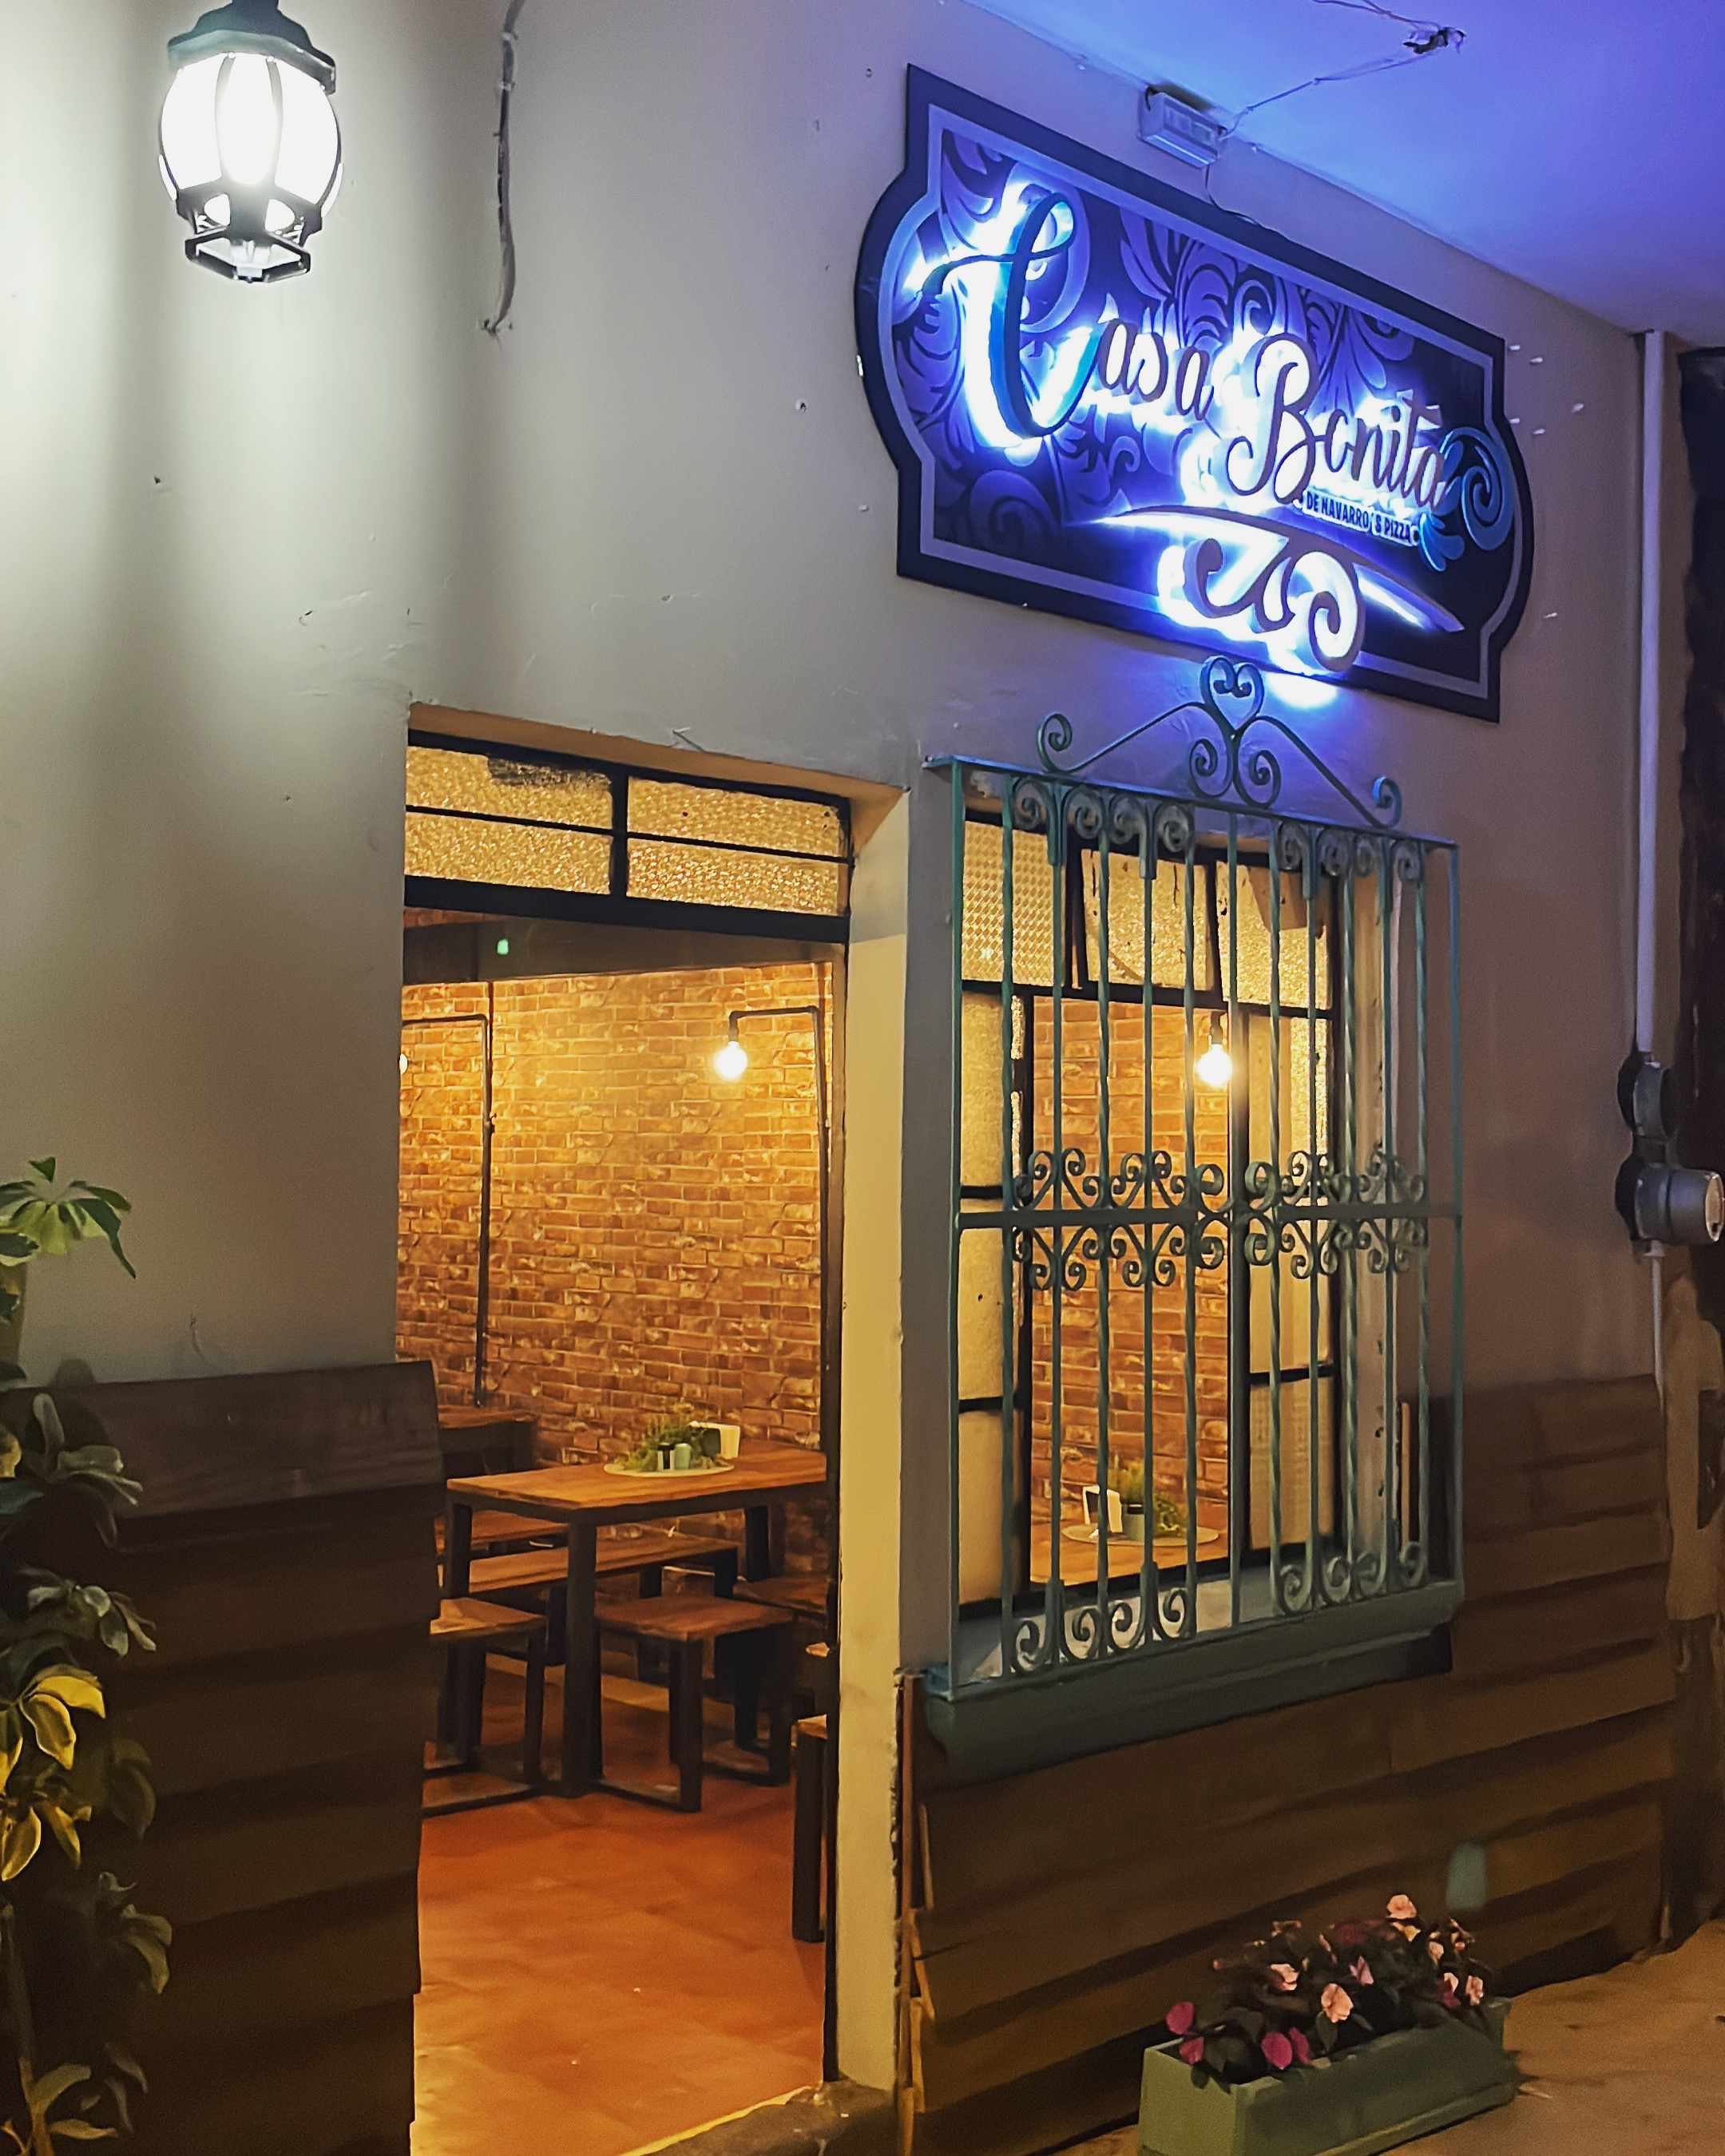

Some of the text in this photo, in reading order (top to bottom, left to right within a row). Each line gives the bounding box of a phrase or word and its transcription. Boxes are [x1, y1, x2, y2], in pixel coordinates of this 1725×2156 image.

[918, 192, 1446, 508] Casa Bonita
[1306, 490, 1319, 512] DE
[1384, 519, 1411, 541] PIZZA
